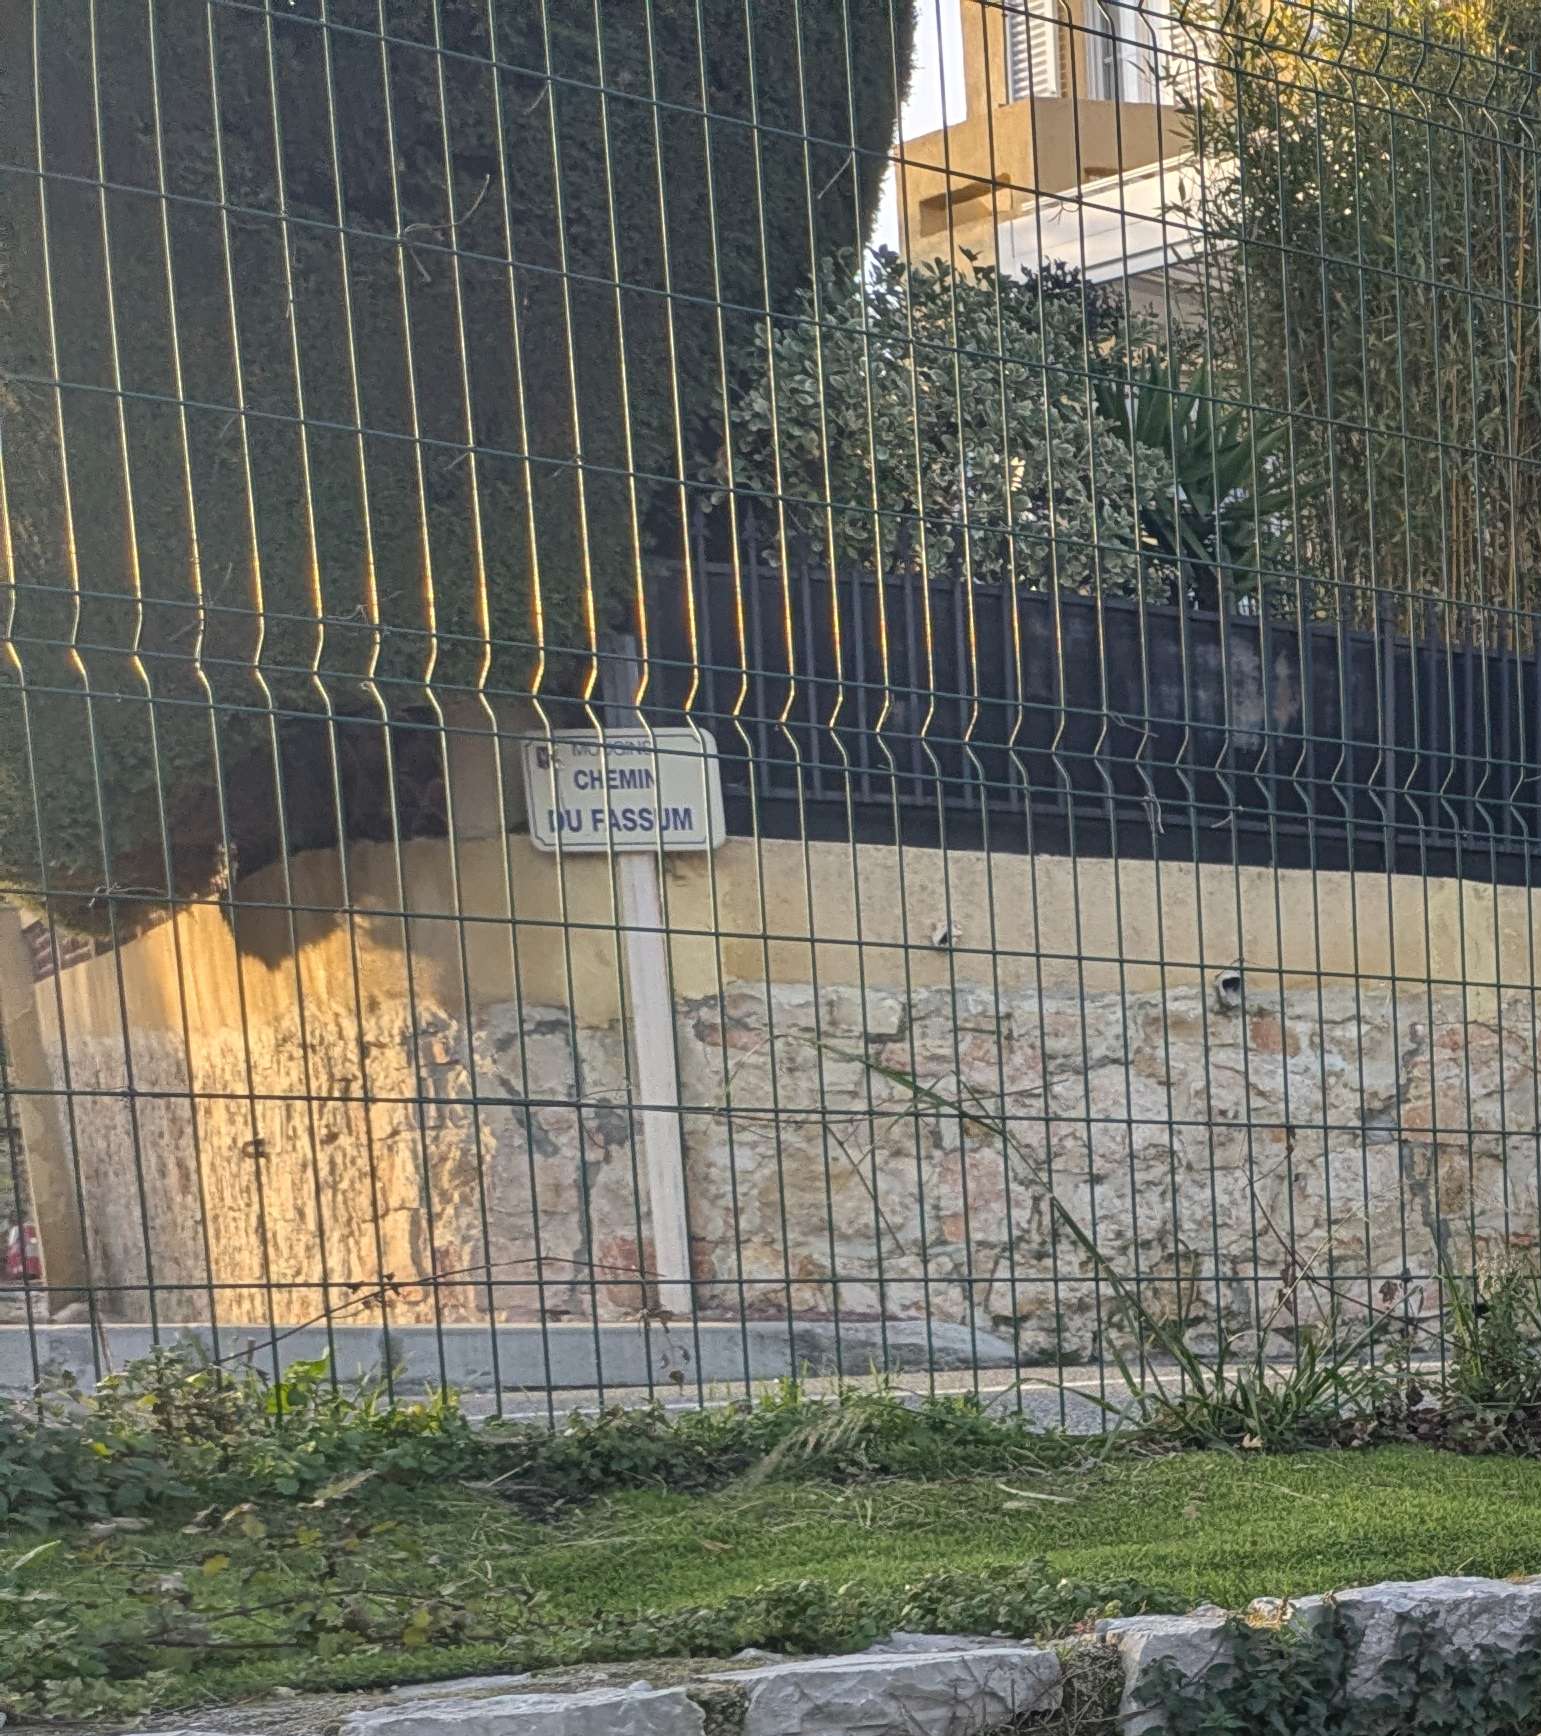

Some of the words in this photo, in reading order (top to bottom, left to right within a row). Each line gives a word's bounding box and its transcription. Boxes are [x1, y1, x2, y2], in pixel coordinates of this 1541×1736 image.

[573, 768, 656, 790] CHEMIN
[548, 808, 582, 833] DU
[592, 807, 693, 832] FASSUM
